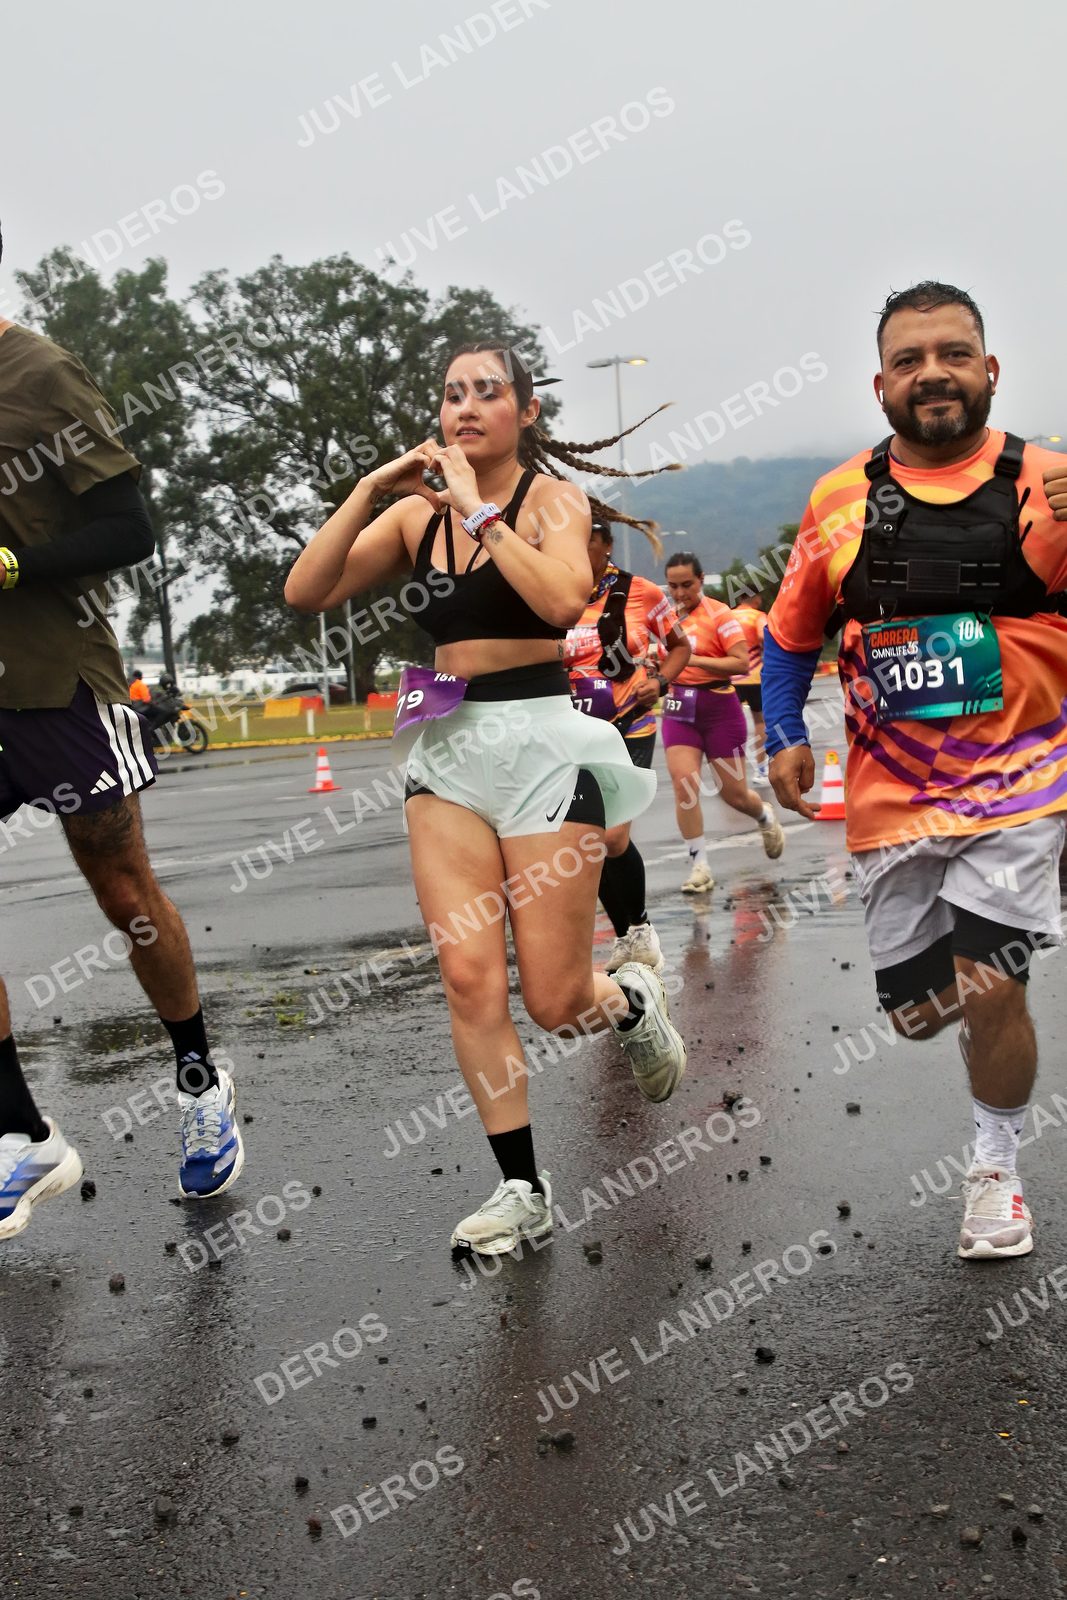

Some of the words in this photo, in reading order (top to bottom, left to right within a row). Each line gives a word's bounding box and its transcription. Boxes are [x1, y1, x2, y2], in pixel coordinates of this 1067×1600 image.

[870, 626, 919, 648] CARRERA
[872, 644, 907, 660] OMNILIFE
[889, 656, 965, 692] 1031
[593, 679, 607, 690] 15K
[666, 698, 682, 711] 737
